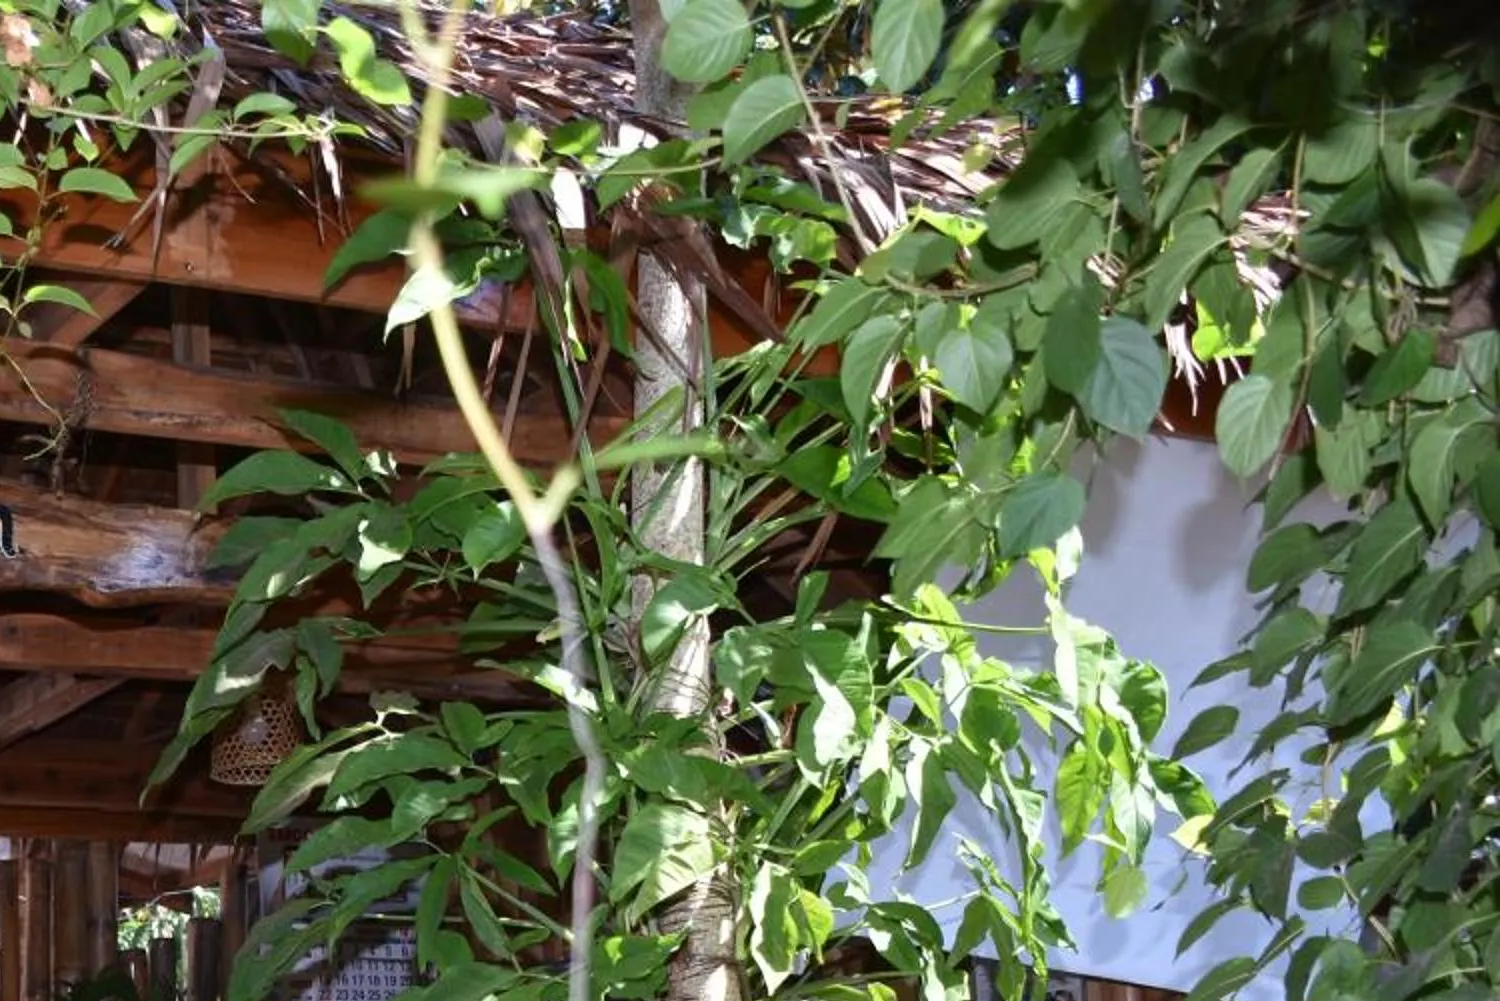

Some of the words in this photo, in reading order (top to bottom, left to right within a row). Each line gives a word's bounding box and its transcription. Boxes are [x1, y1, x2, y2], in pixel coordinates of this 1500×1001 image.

[351, 974, 364, 986] 17
[367, 974, 380, 987] 18
[384, 974, 397, 987] 19
[336, 989, 349, 1001] 23
[352, 989, 365, 1001] 24
[367, 989, 381, 1001] 25
